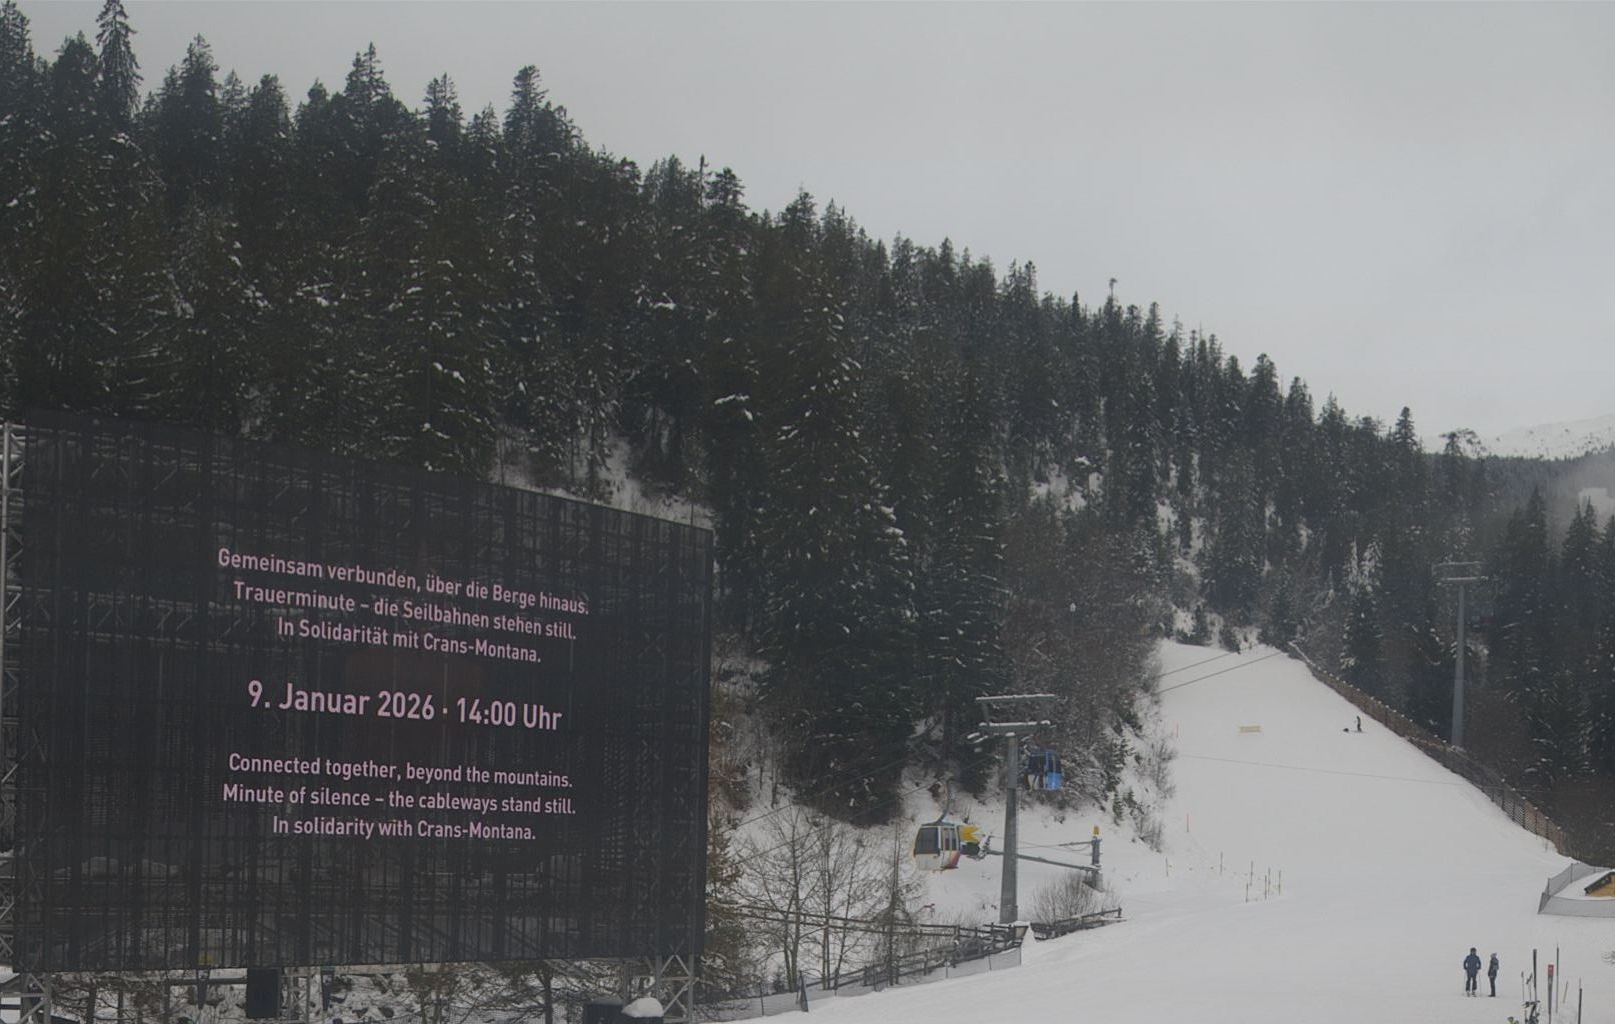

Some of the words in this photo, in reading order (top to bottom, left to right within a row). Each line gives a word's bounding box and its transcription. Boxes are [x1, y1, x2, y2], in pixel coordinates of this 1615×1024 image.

[218, 547, 323, 578] Gemeinsam
[327, 564, 422, 594] verbunden,
[426, 574, 462, 596] über
[466, 581, 489, 600] die
[493, 584, 536, 610] Berge
[540, 591, 589, 615] hinaus.
[233, 580, 355, 611] Trauerminute
[374, 597, 399, 617] die
[403, 601, 489, 628] Seilbahnen
[493, 615, 542, 635] stehen
[545, 621, 577, 640] still.
[278, 616, 294, 636] In
[299, 619, 389, 645] Solidarität
[393, 630, 419, 649] mit
[423, 632, 541, 663] Crans-Montana.
[248, 679, 270, 707] 9.
[278, 682, 371, 715] Januar
[377, 690, 434, 720] 2026
[457, 697, 516, 727] 14:00
[523, 703, 562, 729] Uhr
[229, 752, 321, 774] Connected
[326, 759, 402, 781] together,
[406, 762, 462, 784] beyond
[466, 766, 490, 783] the
[494, 771, 573, 788] mountains.
[223, 783, 284, 803] Minute
[289, 786, 306, 804] of
[310, 787, 371, 806] silence
[389, 790, 414, 808] the
[418, 792, 498, 815] cableways
[501, 797, 541, 813] stand
[544, 798, 576, 814] still.
[273, 816, 289, 834] In
[293, 817, 374, 840] solidarity
[378, 819, 413, 837] with
[417, 820, 536, 840] Crans-Montana.
